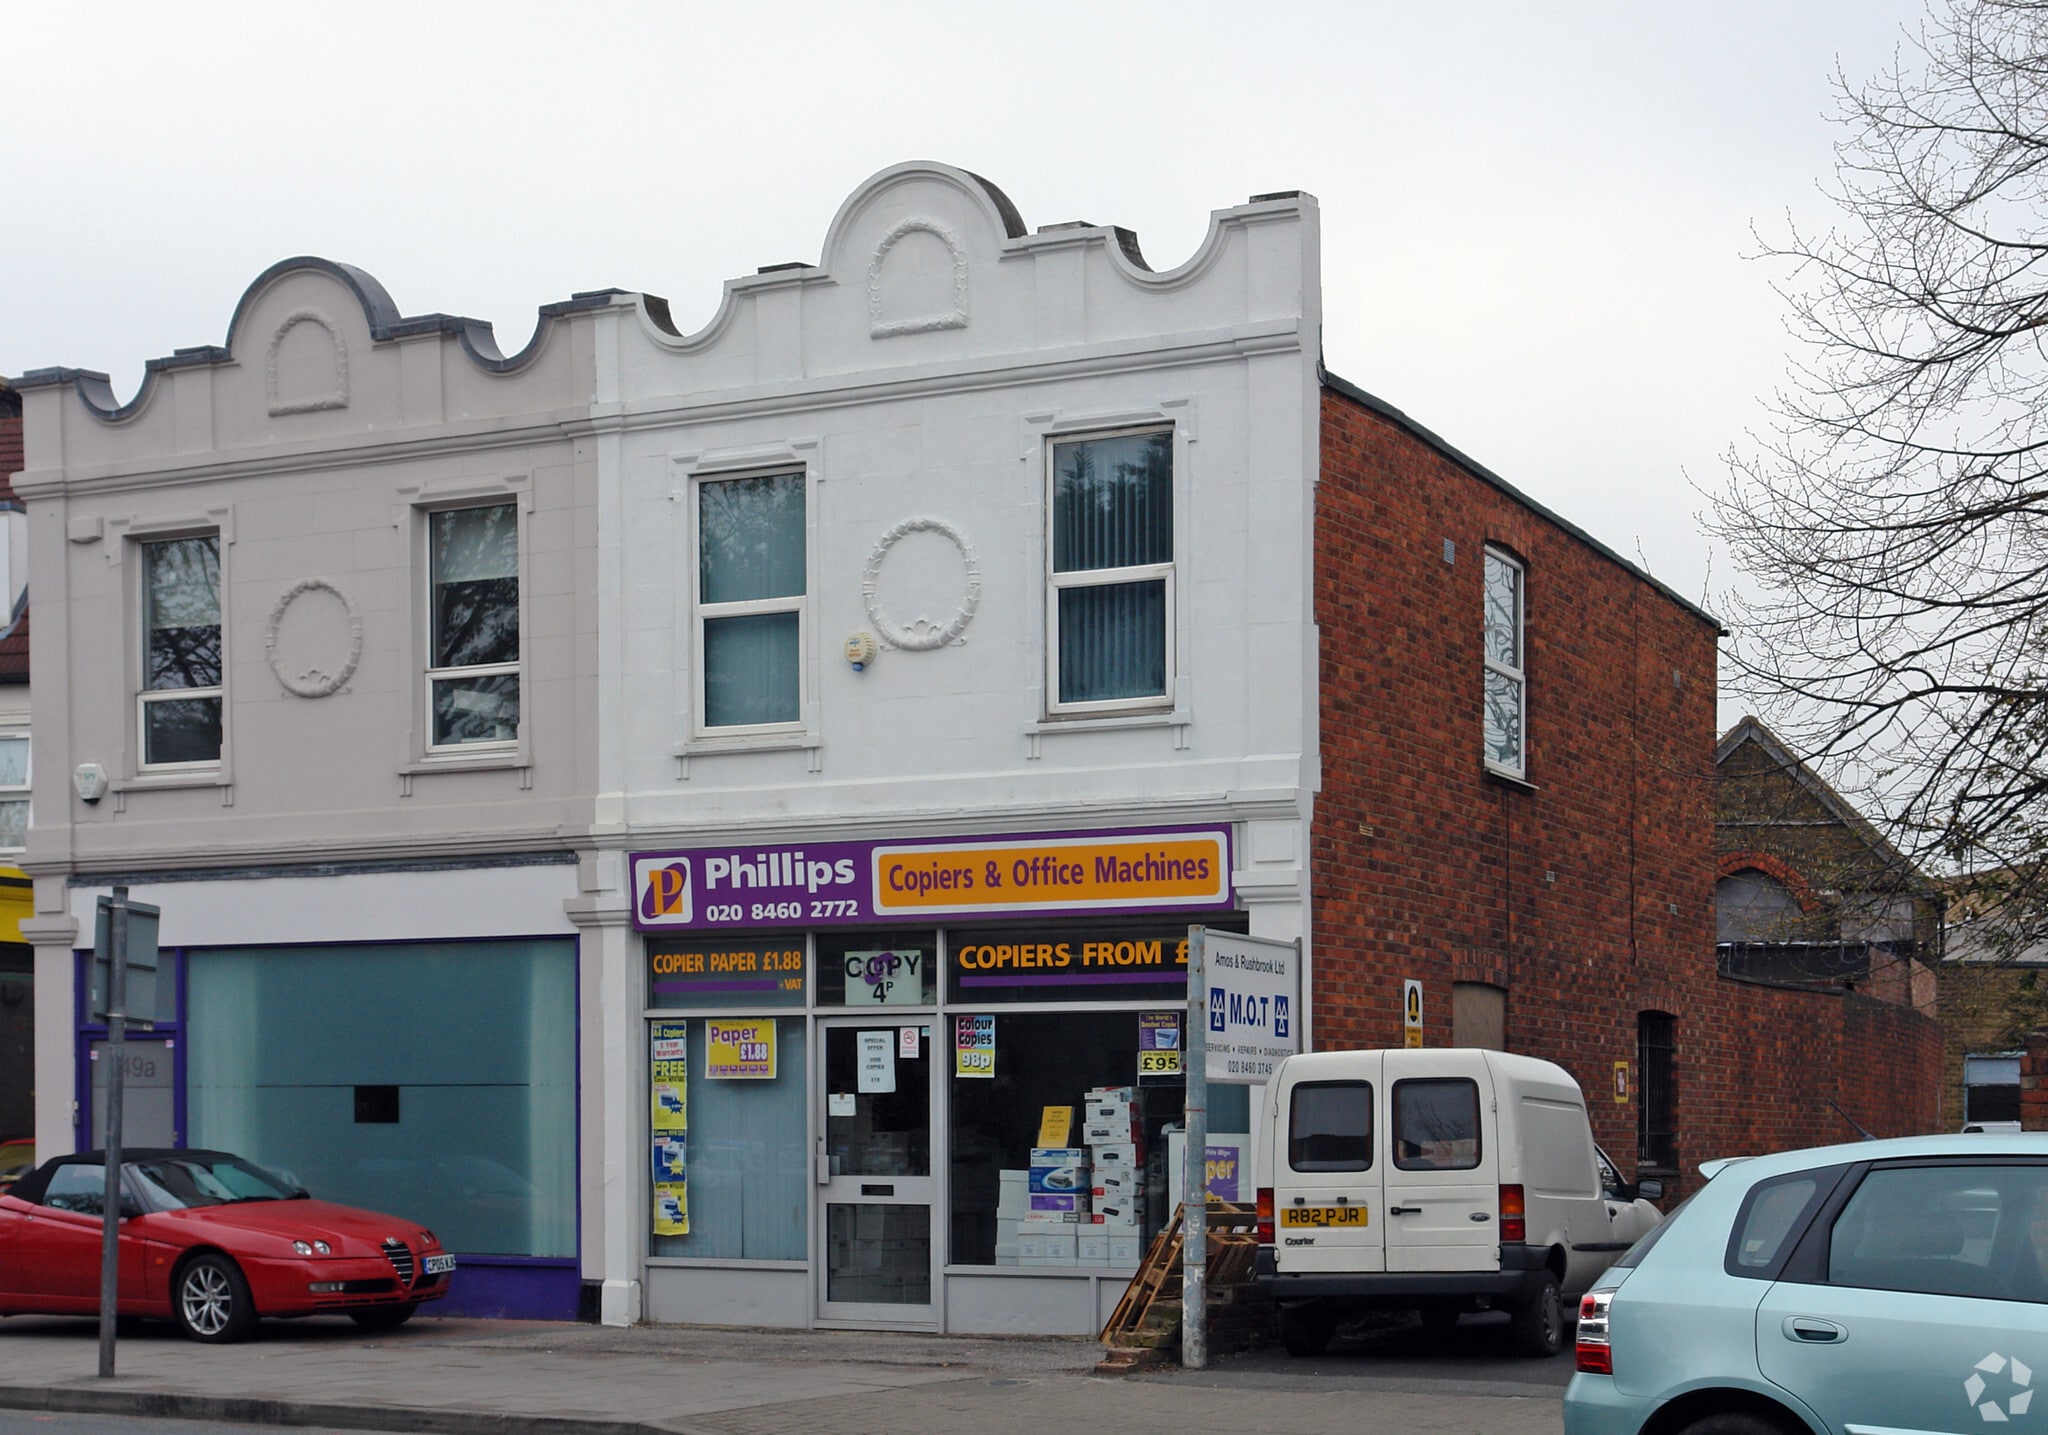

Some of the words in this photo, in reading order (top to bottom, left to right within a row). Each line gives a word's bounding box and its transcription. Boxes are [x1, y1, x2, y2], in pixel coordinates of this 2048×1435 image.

[705, 852, 856, 893] Phillips
[888, 862, 974, 897] Copiers
[985, 860, 1001, 888] &
[1012, 856, 1084, 887] Office
[1095, 852, 1209, 884] Machines
[706, 904, 743, 921] 020
[751, 902, 801, 920] 8460
[810, 900, 858, 918] 2772
[653, 954, 704, 974] COPIER
[710, 952, 757, 972] PAPER
[762, 951, 802, 971] £1.88
[959, 943, 1071, 969] COPIERS
[1083, 940, 1162, 966] FROM
[1215, 951, 1234, 969] Amos
[1234, 953, 1240, 969] &
[1240, 955, 1274, 974] Rushbrook
[1274, 960, 1285, 975] Ltd
[845, 954, 920, 978] COPY
[1229, 993, 1269, 1028] M.O.T
[959, 1017, 992, 1030] Colour
[710, 1026, 758, 1048] Paper
[959, 1031, 992, 1046] Copies
[740, 1043, 767, 1060] £1.88
[1205, 1042, 1230, 1053] SERVICING
[1237, 1045, 1257, 1056] REPAIRS
[1264, 1047, 1295, 1057] DIAGNOSTICS
[653, 1061, 686, 1076] FREE
[962, 1052, 991, 1069] 98p
[1143, 1057, 1178, 1070] £95
[1228, 1060, 1239, 1073] 020
[1241, 1061, 1256, 1074] 8460
[1258, 1063, 1272, 1075] 3745
[1205, 1160, 1235, 1186] per
[1288, 1208, 1322, 1223] R82
[1325, 1207, 1359, 1223] PJR
[1285, 1237, 1315, 1245] Courier
